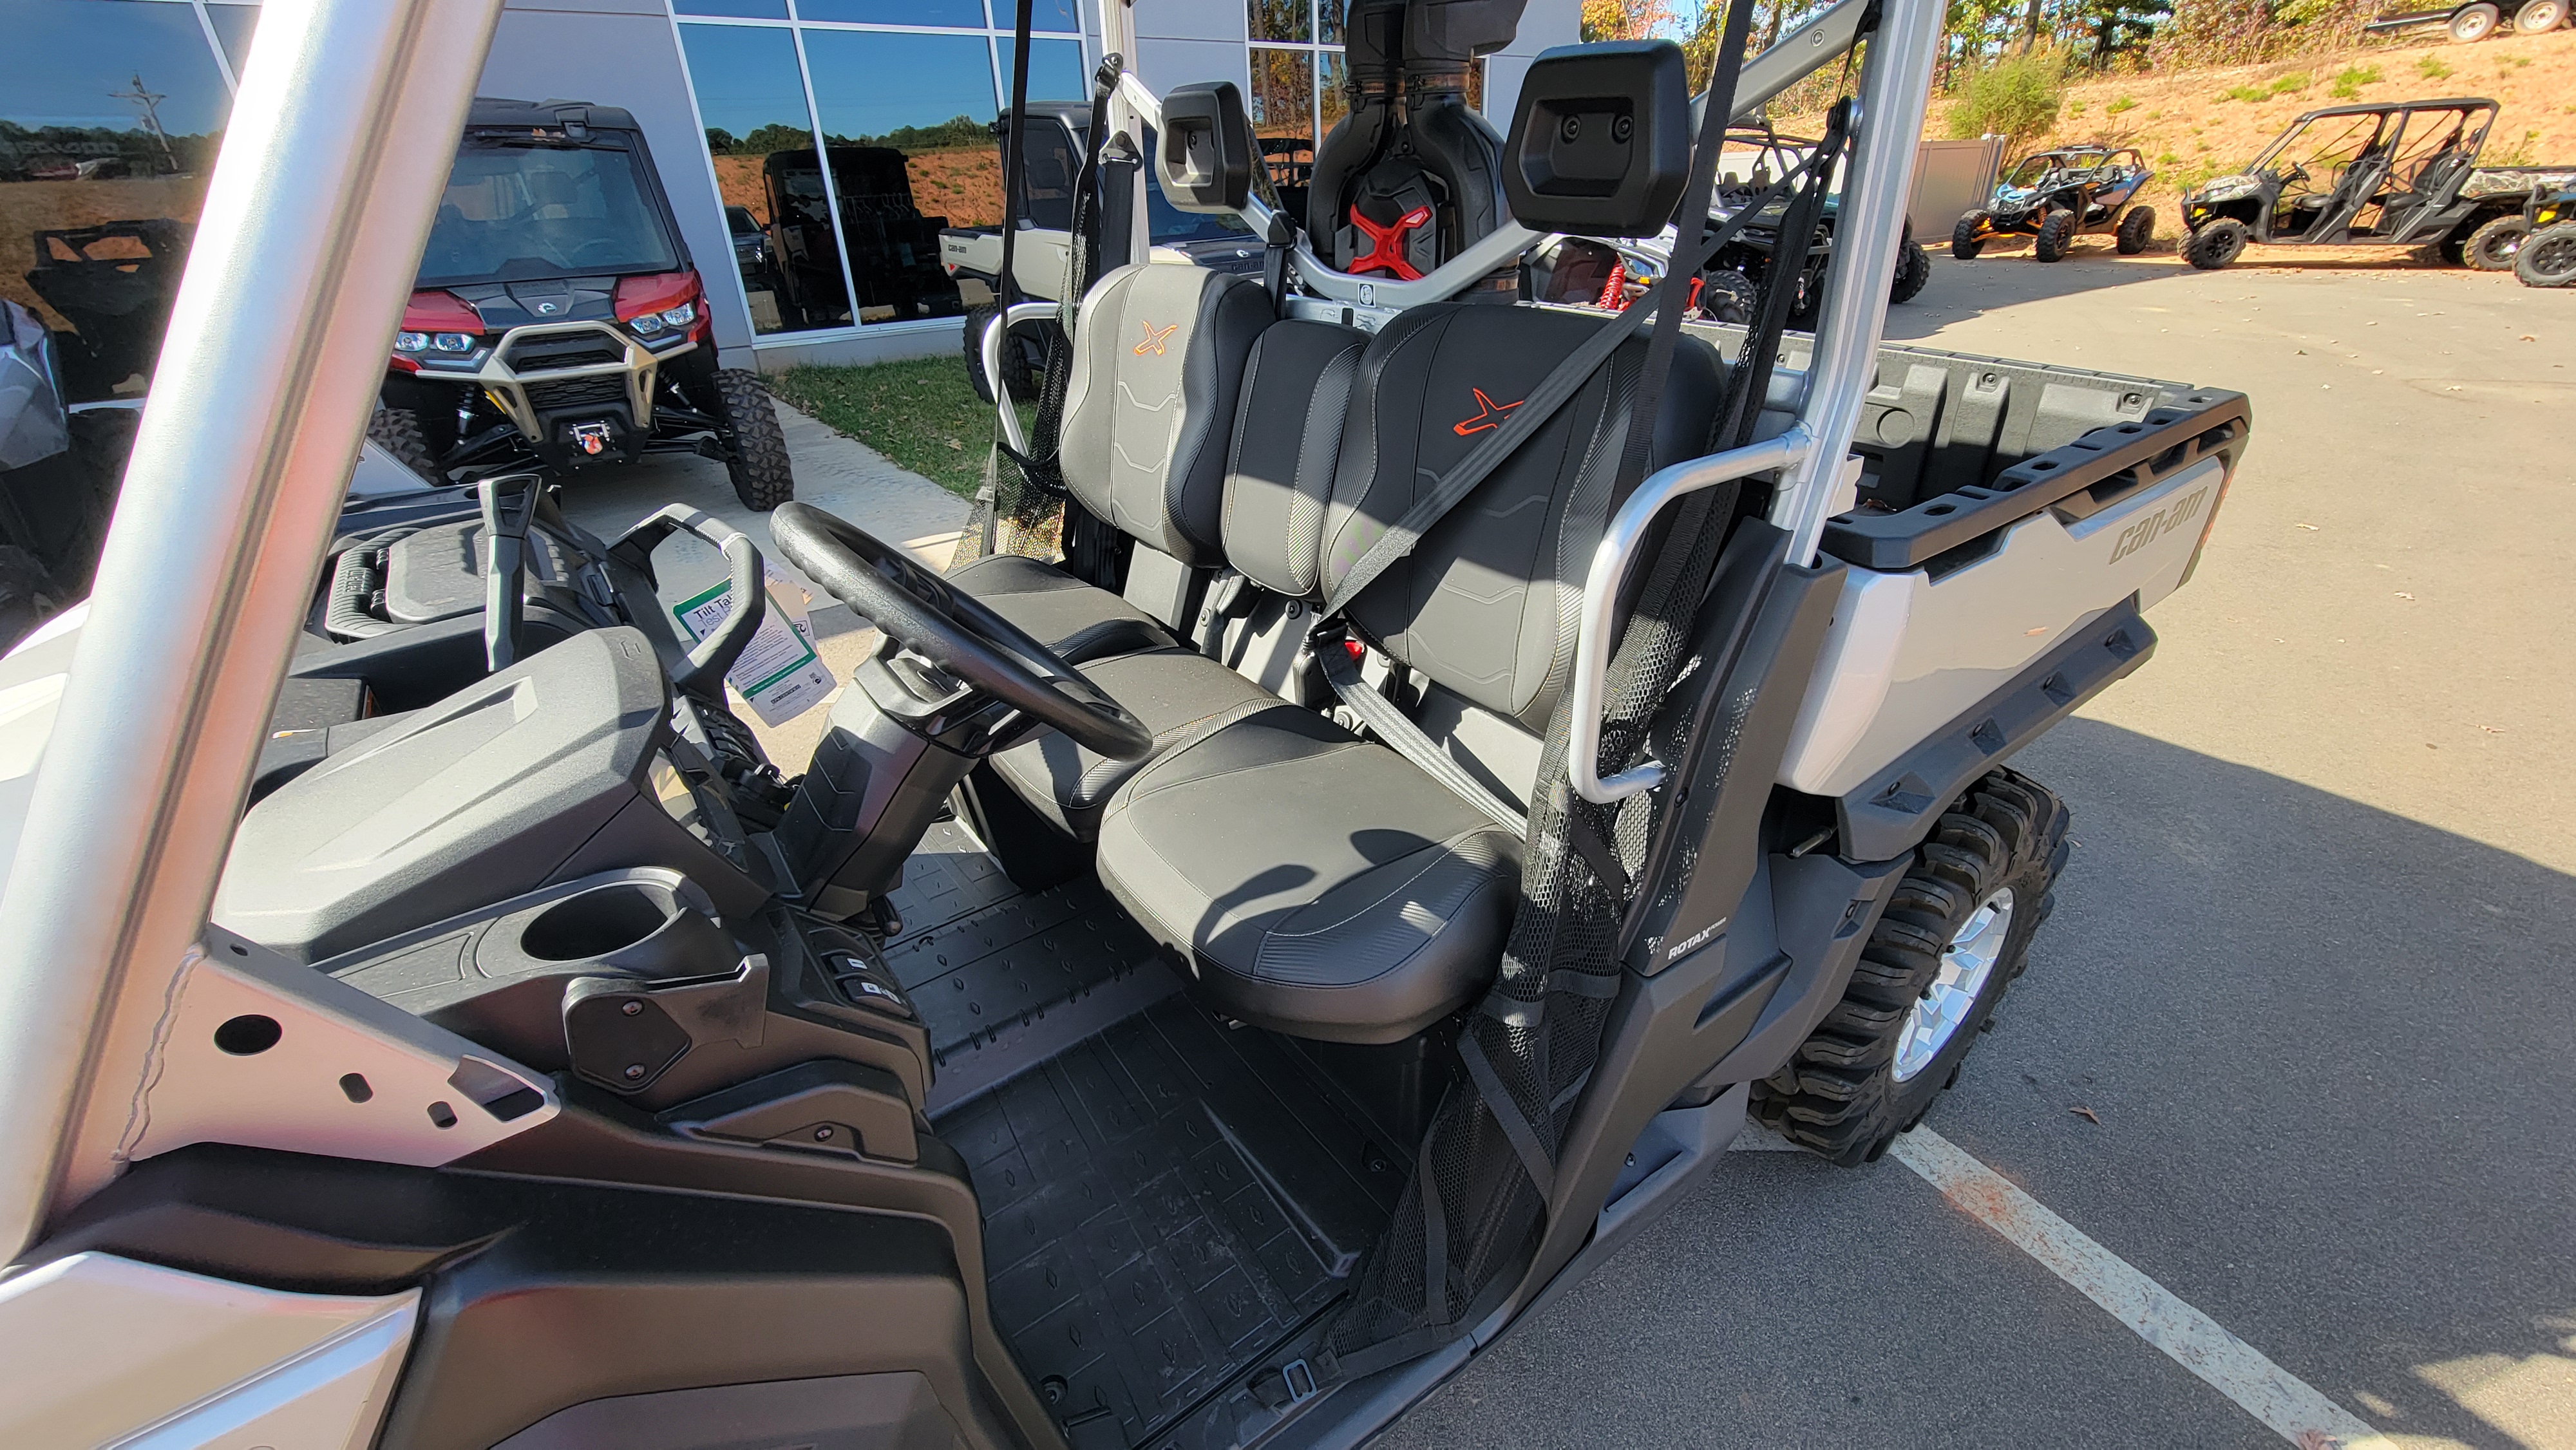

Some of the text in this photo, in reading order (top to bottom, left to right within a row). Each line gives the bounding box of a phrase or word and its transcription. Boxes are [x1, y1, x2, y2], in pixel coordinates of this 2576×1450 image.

[948, 244, 967, 254] can-am
[2109, 485, 2208, 565] can-am
[693, 605, 715, 619] Tilt
[697, 612, 723, 627] Test
[1668, 927, 1710, 960] ROTAX
